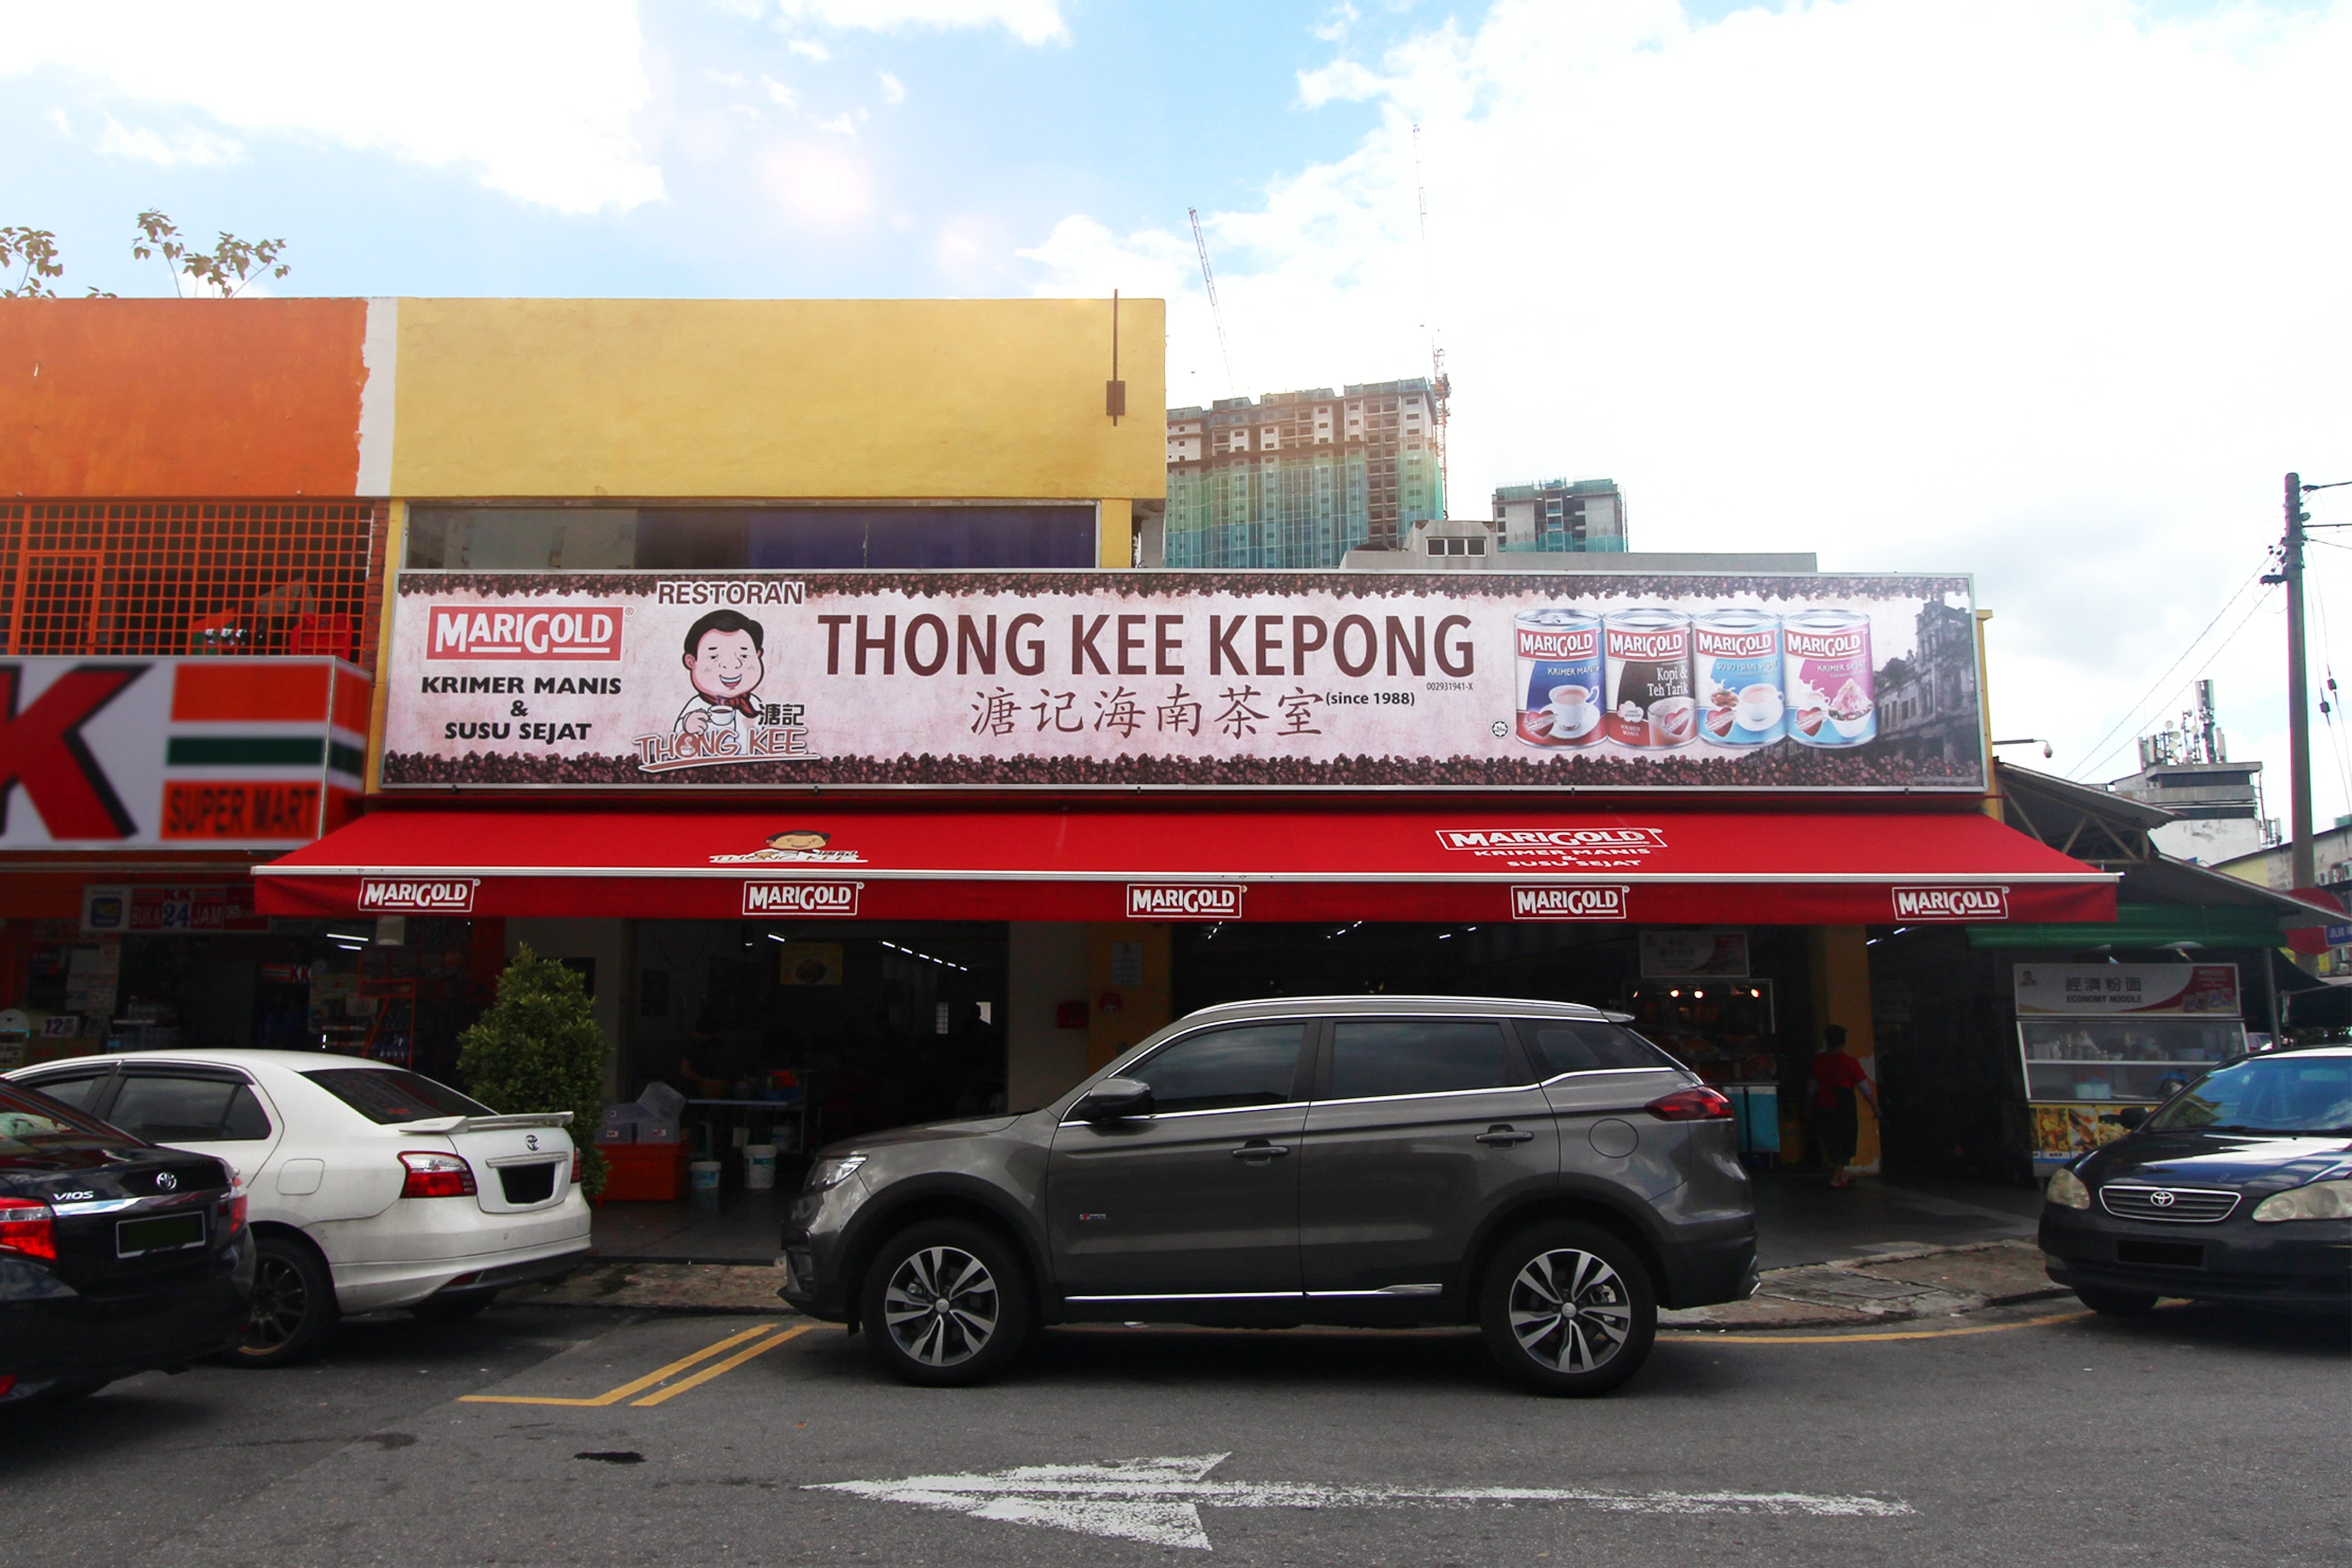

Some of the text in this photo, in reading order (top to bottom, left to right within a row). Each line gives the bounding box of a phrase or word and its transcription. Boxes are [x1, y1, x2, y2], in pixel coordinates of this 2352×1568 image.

[658, 583, 803, 605] RESTORAN
[434, 613, 613, 653] MARIGOLD
[1699, 633, 1772, 656] MARIGOLD
[818, 613, 1474, 677] THONG KEE KEPONG
[1520, 633, 1593, 657] MARIGOLD
[1610, 633, 1682, 657] MARIGOLD
[1788, 633, 1861, 657] MARIGOLD
[1548, 664, 1600, 676] KRIMER MANIS
[1656, 666, 1688, 684] Kopi &
[1717, 663, 1737, 671] SUSU
[1817, 660, 1867, 672] KRIMER SEJAT
[421, 676, 622, 695] KRIMER MANIS
[1426, 682, 1473, 691] 002931941-X
[1647, 682, 1689, 696] Teh Tarik
[510, 700, 528, 717] &
[1326, 692, 1415, 706] (since 1988)
[758, 704, 804, 726] 溏記
[971, 683, 1324, 740] 溏记海南茶室
[445, 722, 592, 745] SUSU SEJAT
[634, 728, 807, 764] THONG KEE
[168, 788, 318, 833] SUPER MART
[1449, 830, 1646, 847] MARIGOLD
[164, 888, 192, 901] KK
[365, 883, 467, 906] MARIGOLD
[749, 886, 852, 910] MARIGOLD
[1132, 889, 1235, 913] MARIGOLD
[1517, 890, 1618, 914] MARIGOLD
[1898, 891, 2000, 915] MARIGOLD
[132, 905, 161, 925] BUKA
[162, 903, 190, 927] 24
[192, 904, 222, 925] JAM
[2067, 995, 2142, 1003] ECONOMY NOODLE
[54, 1191, 94, 1201] VIOS
